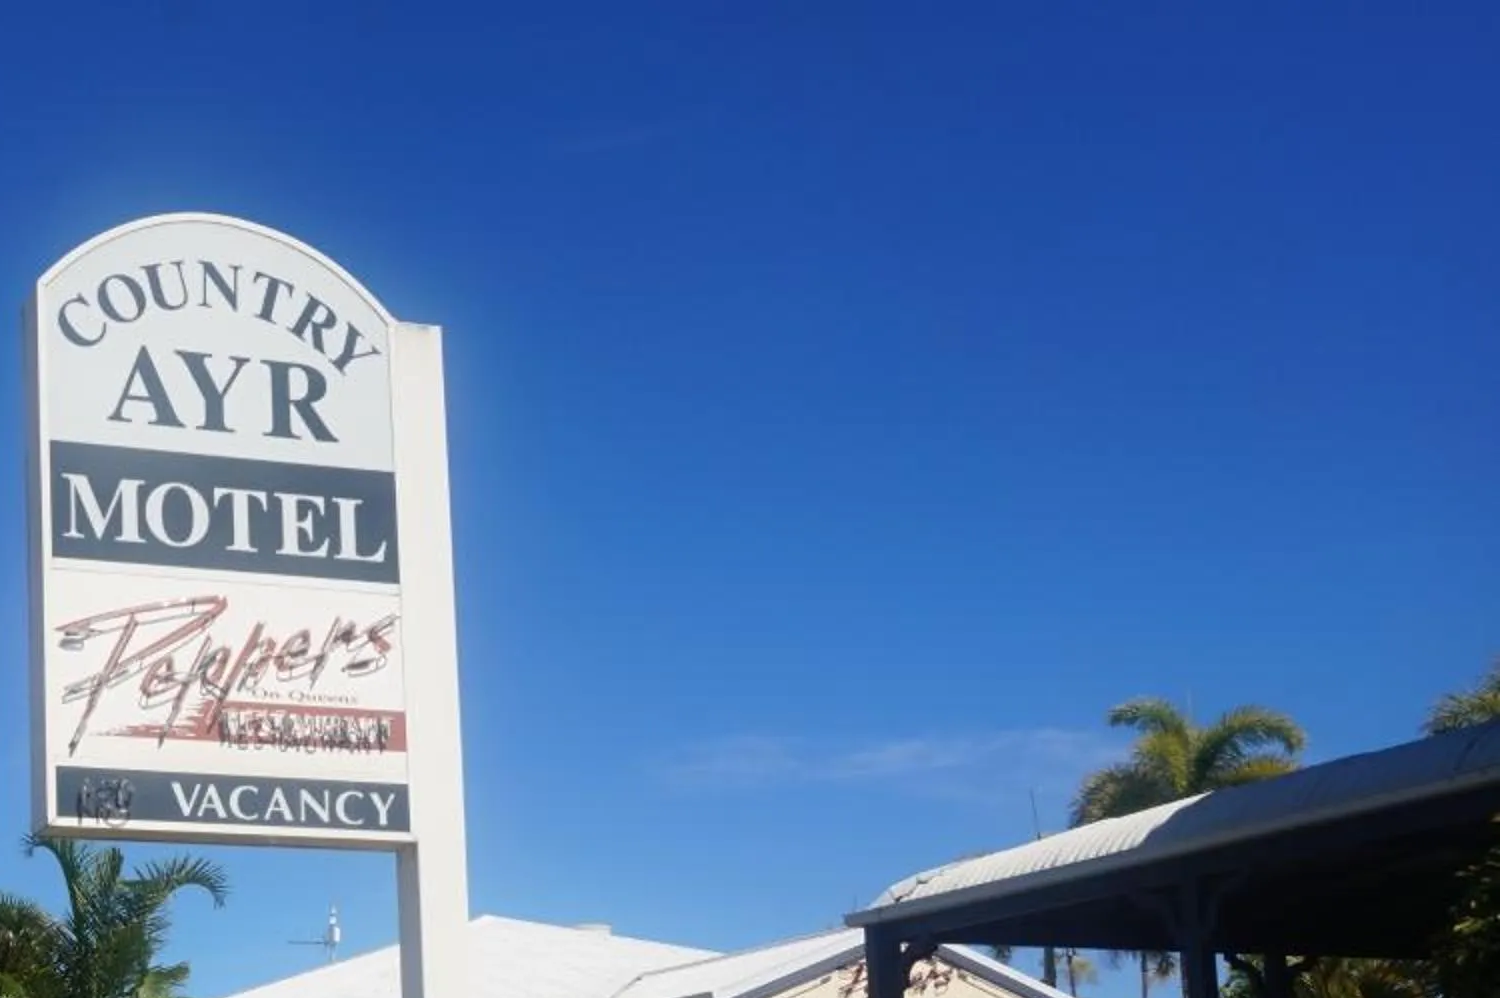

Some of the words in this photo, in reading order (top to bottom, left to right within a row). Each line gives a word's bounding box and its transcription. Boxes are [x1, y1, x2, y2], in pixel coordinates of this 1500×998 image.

[57, 260, 381, 376] COUNTRY
[107, 345, 339, 443] AYR
[61, 473, 388, 564] MOTEL
[172, 781, 395, 827] VACANCY
